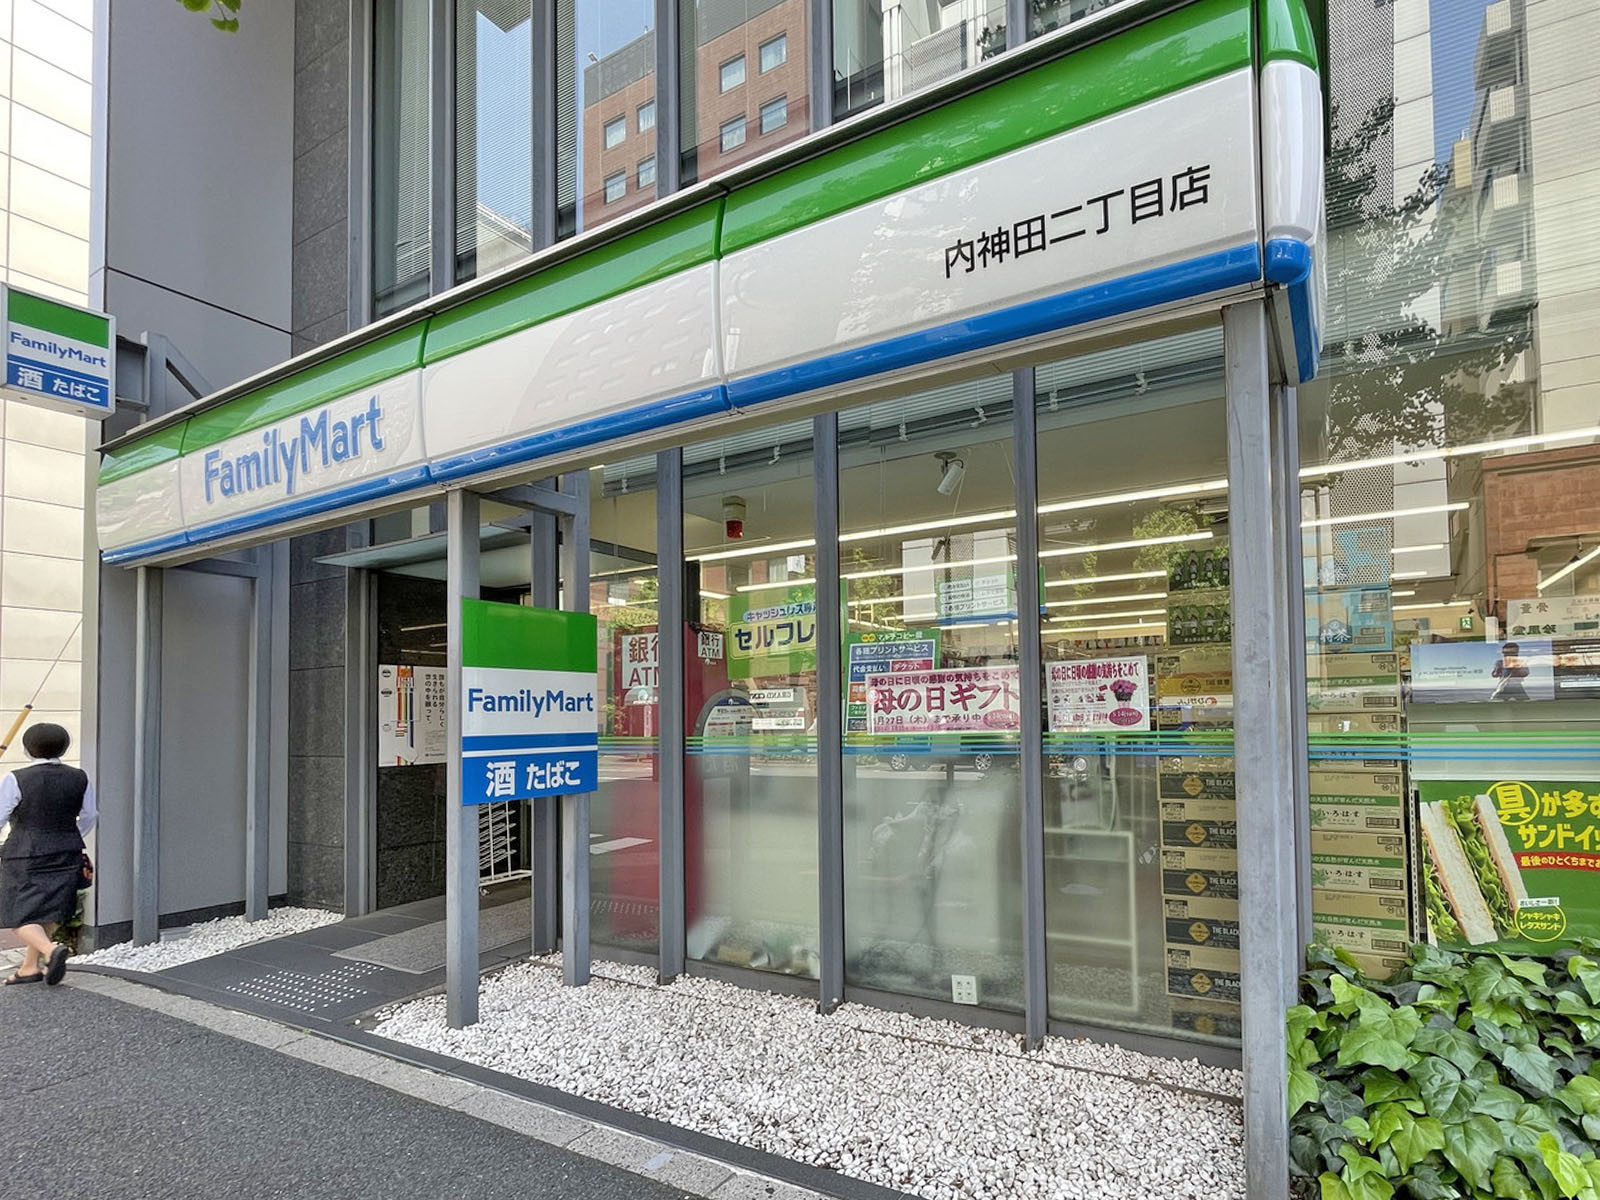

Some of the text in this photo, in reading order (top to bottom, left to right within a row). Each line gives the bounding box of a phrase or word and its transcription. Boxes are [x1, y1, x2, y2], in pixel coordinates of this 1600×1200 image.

[945, 164, 1210, 278] 内神田二丁目店
[10, 331, 107, 368] FamilyMart
[17, 366, 101, 402] 酒 たばこ
[203, 394, 384, 503] FamilyMart
[701, 647, 721, 658] ATM
[468, 688, 594, 718] FamilyMart
[486, 760, 581, 797] 酒 たばこ
[1518, 823, 1600, 850] サンドイ
